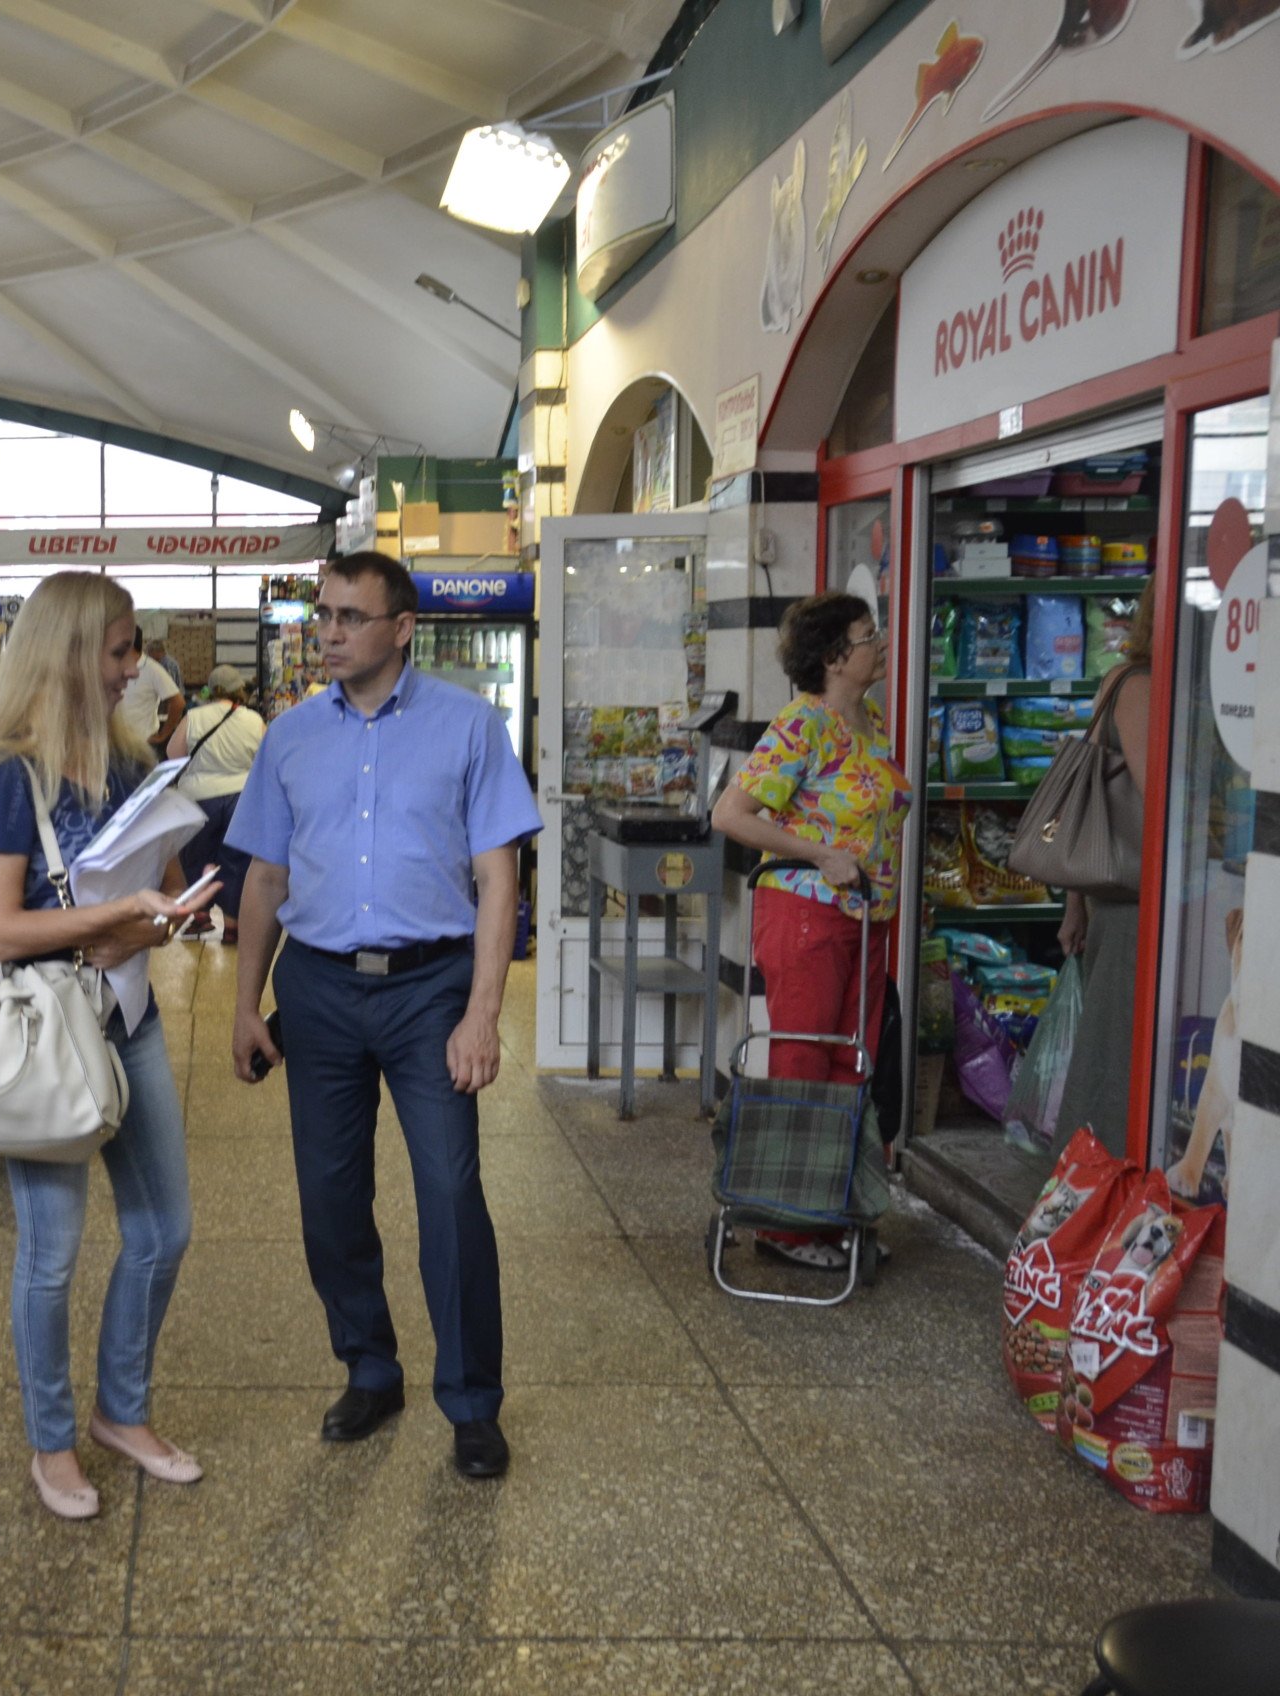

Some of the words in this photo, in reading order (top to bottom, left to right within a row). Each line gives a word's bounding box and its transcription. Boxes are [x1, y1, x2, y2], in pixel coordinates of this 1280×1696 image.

[934, 291, 1012, 377] ROYAL
[1019, 236, 1124, 342] CANIN
[28, 535, 117, 555] ЦВЕТЫ
